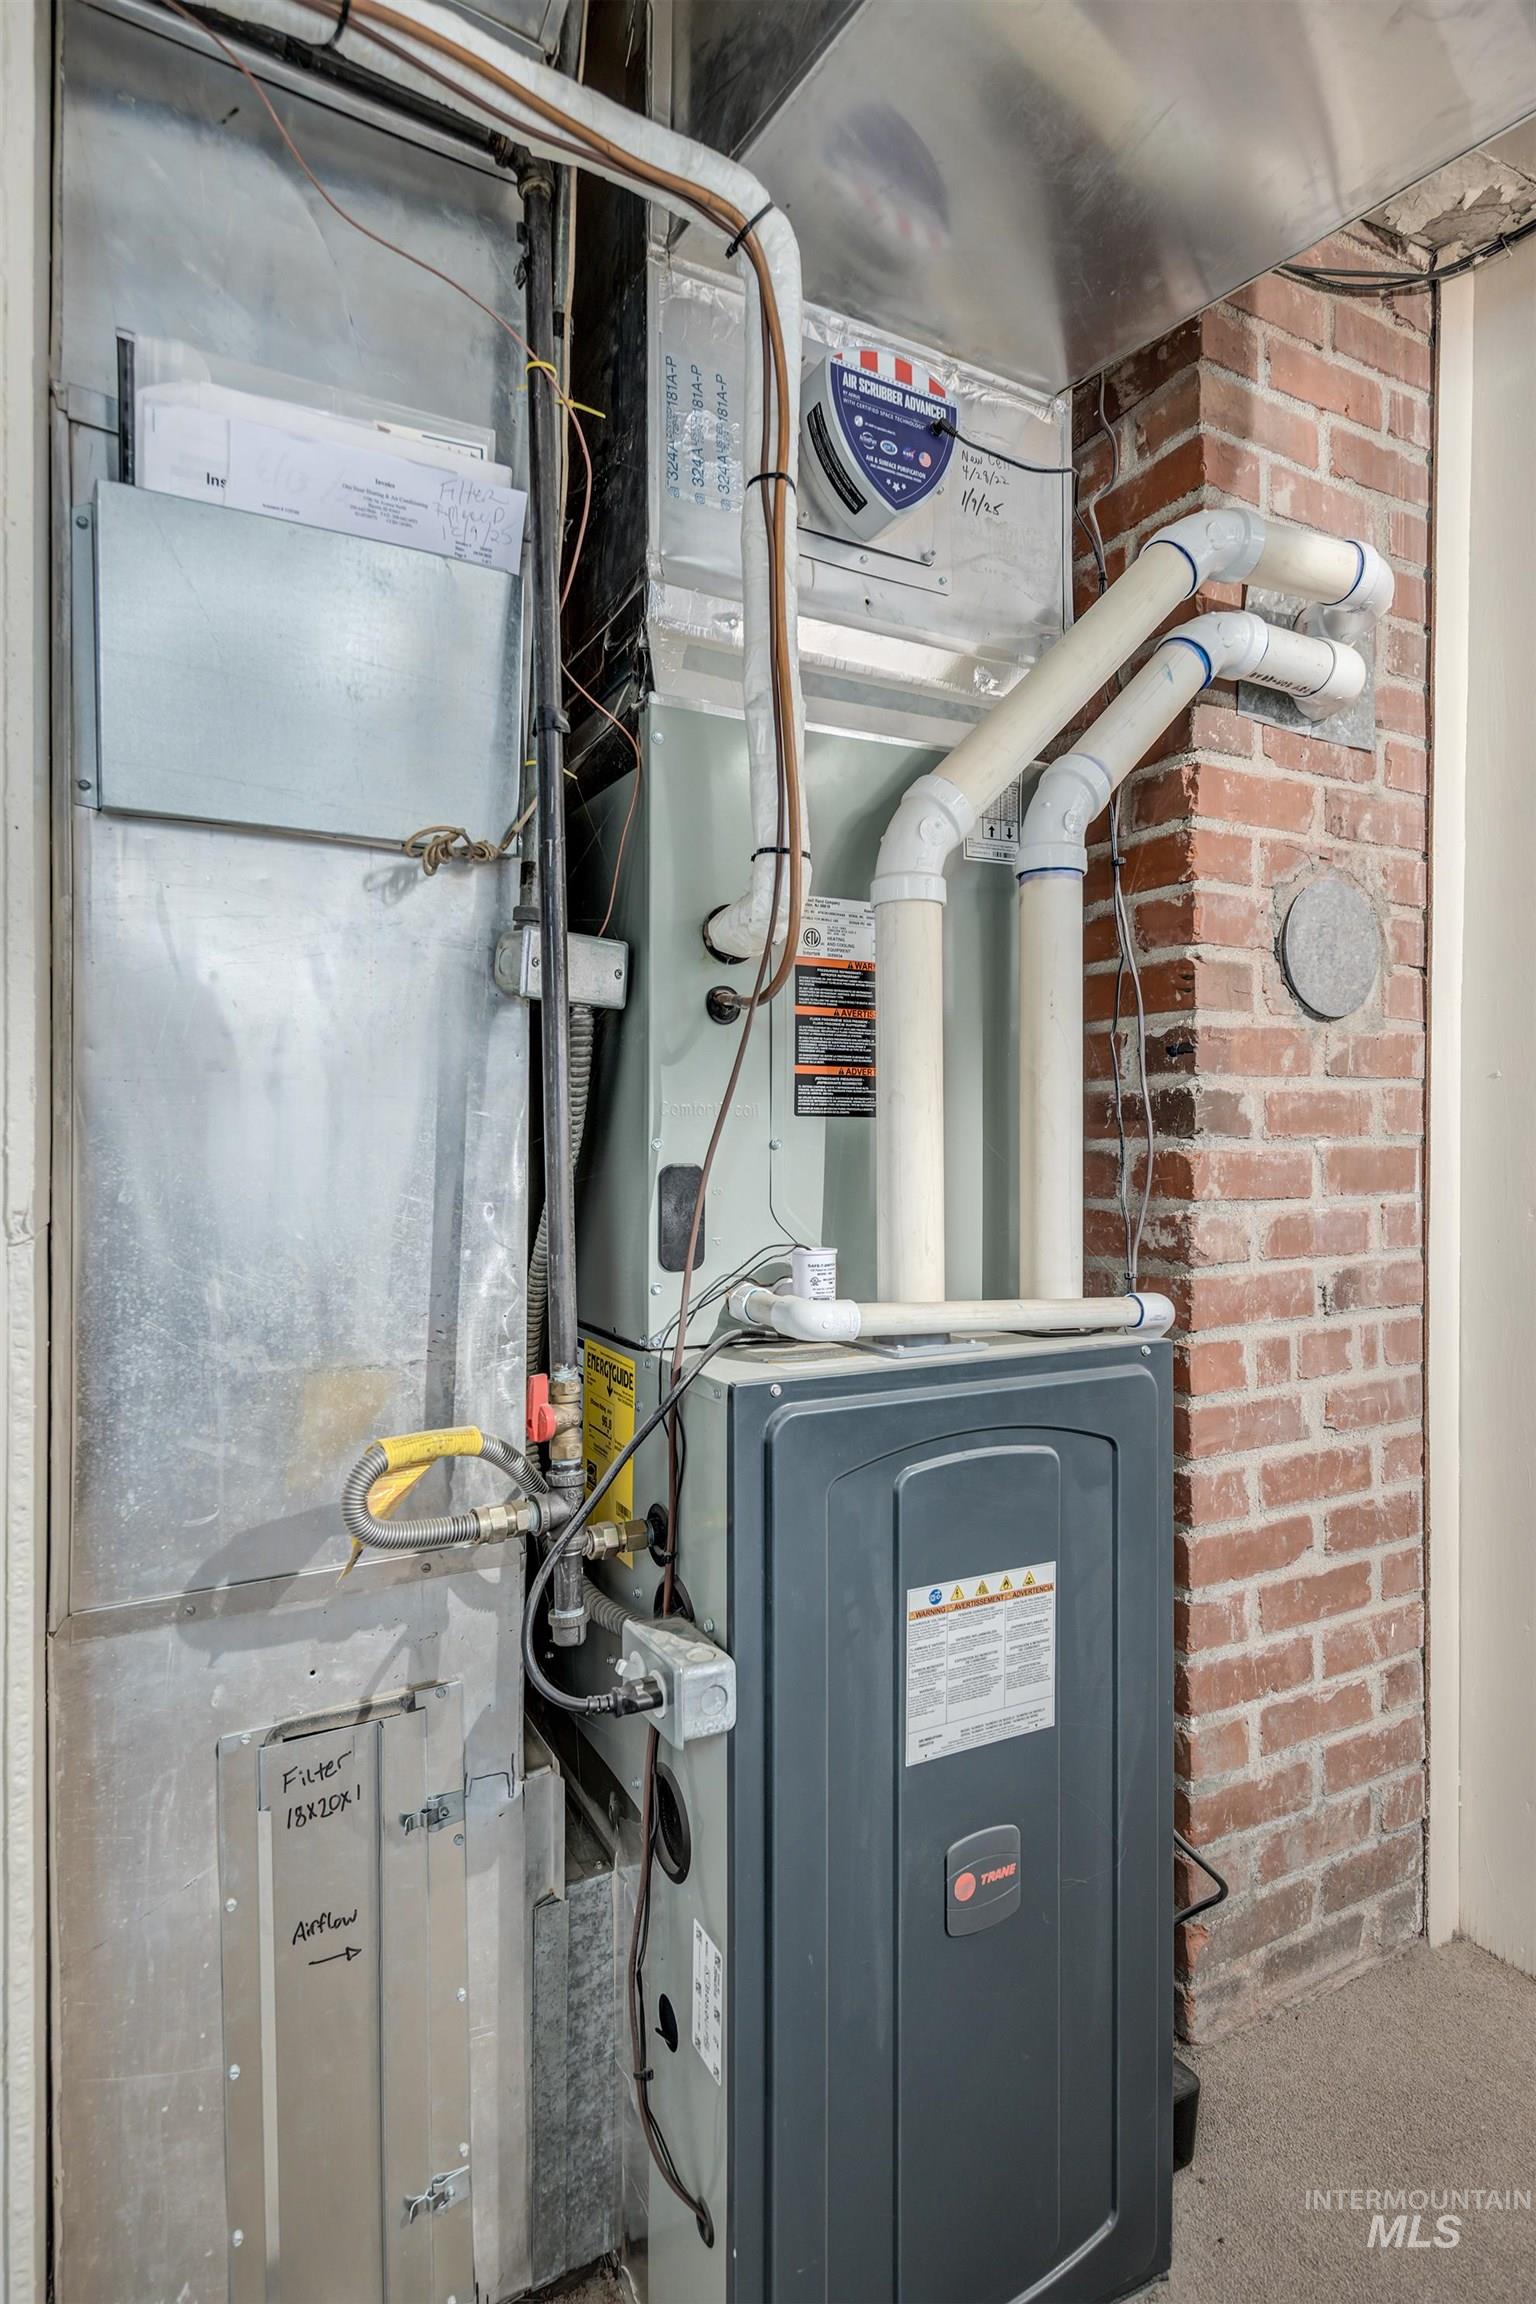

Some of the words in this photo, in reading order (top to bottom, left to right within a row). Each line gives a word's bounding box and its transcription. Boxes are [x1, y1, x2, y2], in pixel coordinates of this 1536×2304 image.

[666, 356, 678, 406] 181A-P
[691, 364, 703, 412] 181A-P
[716, 374, 728, 422] 181A-P
[842, 372, 858, 391] AIR
[858, 377, 903, 407] SCRUBBER
[905, 394, 946, 420] ADVANCED
[667, 442, 679, 481] 324A
[692, 447, 704, 488] 324A
[717, 455, 730, 494] 324A
[962, 449, 983, 465] New
[854, 961, 875, 970] WAR
[587, 1352, 634, 1391] ENERGYGUIDE
[915, 1606, 946, 1619] WARNING
[954, 1594, 1004, 1610] AVERTISSEMENT
[1012, 1584, 1054, 1598] ADVERTENCIA
[282, 1751, 352, 1794] Filter
[980, 1863, 1017, 1886] TRANE
[292, 1909, 358, 1946] Airflow
